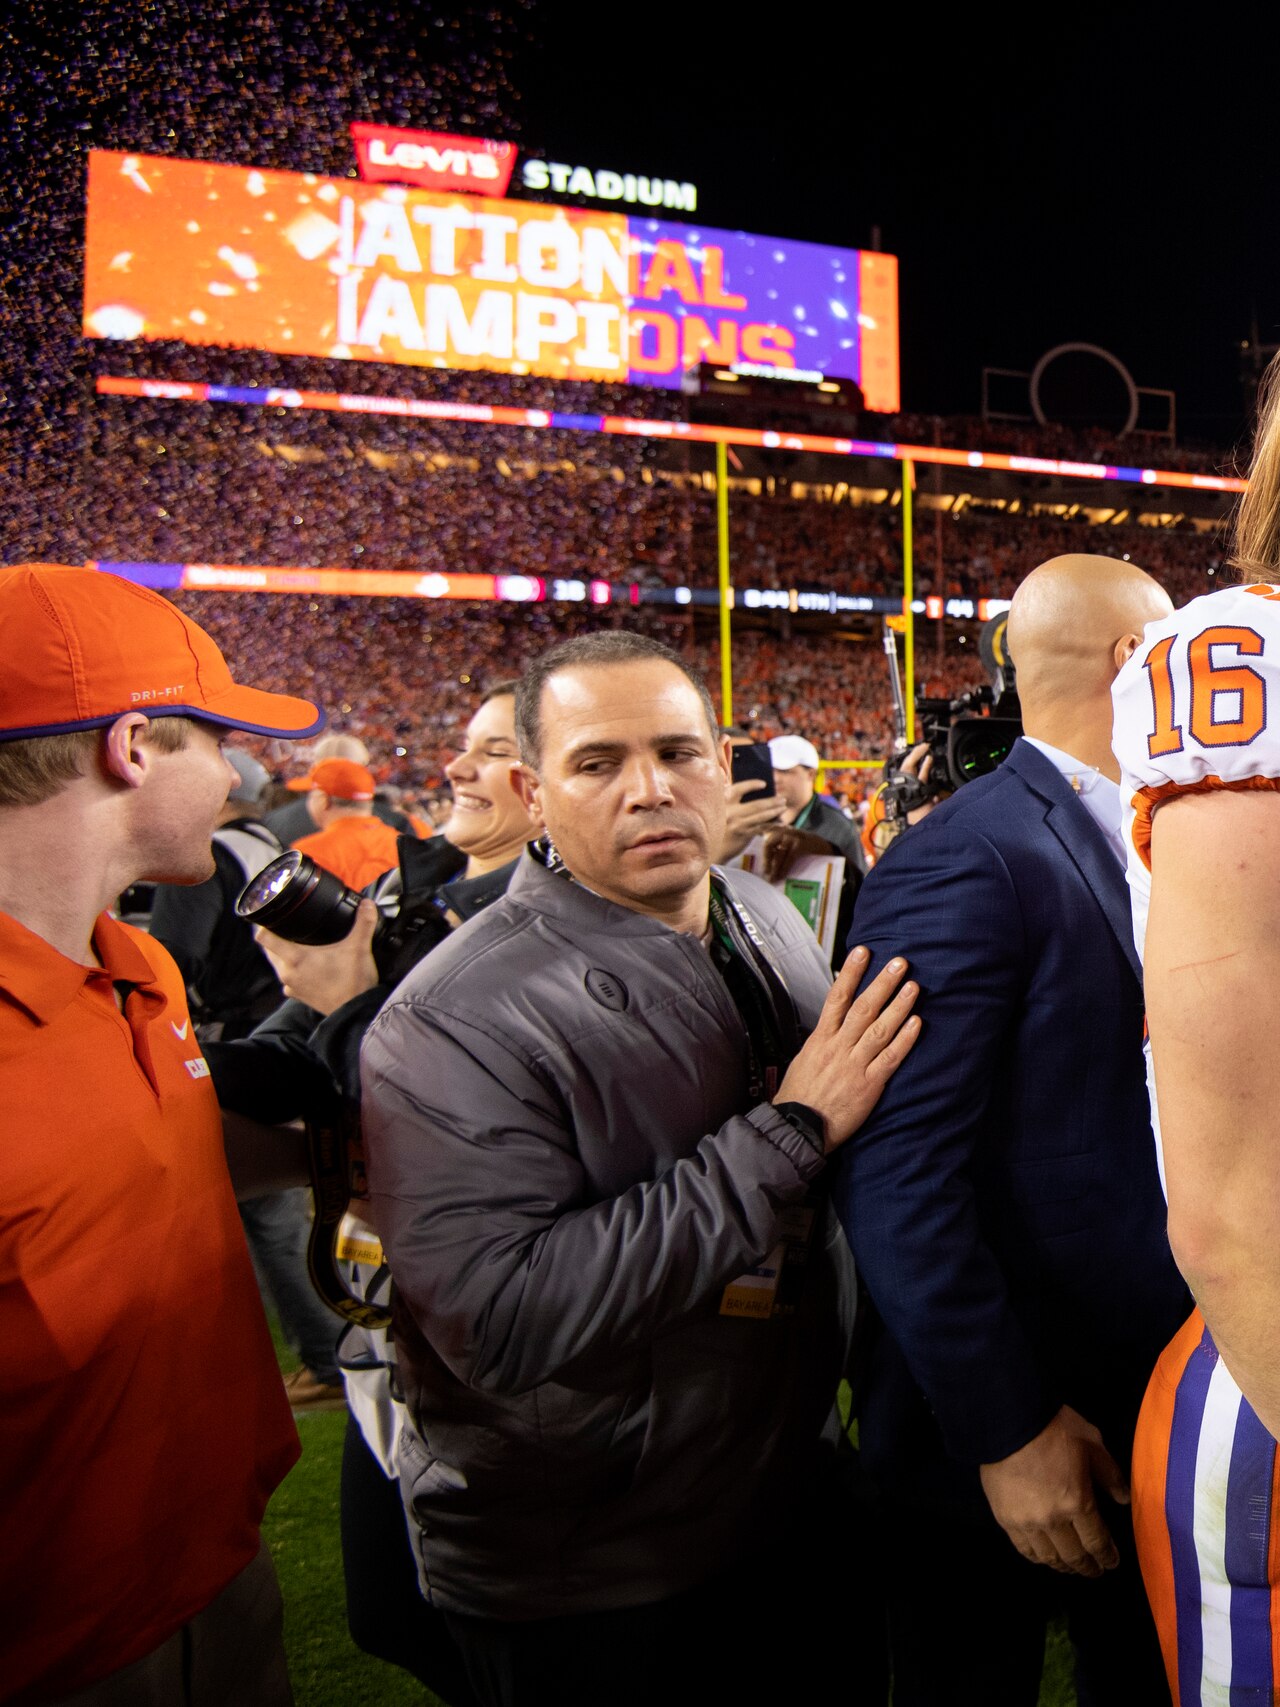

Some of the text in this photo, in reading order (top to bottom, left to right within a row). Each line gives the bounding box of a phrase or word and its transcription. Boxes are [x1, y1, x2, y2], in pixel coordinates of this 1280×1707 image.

[523, 159, 697, 212] STADIUM
[338, 270, 797, 372] AMPIONS
[131, 685, 185, 702] DRI-FIT
[1142, 625, 1268, 760] 16
[733, 901, 764, 947] POST
